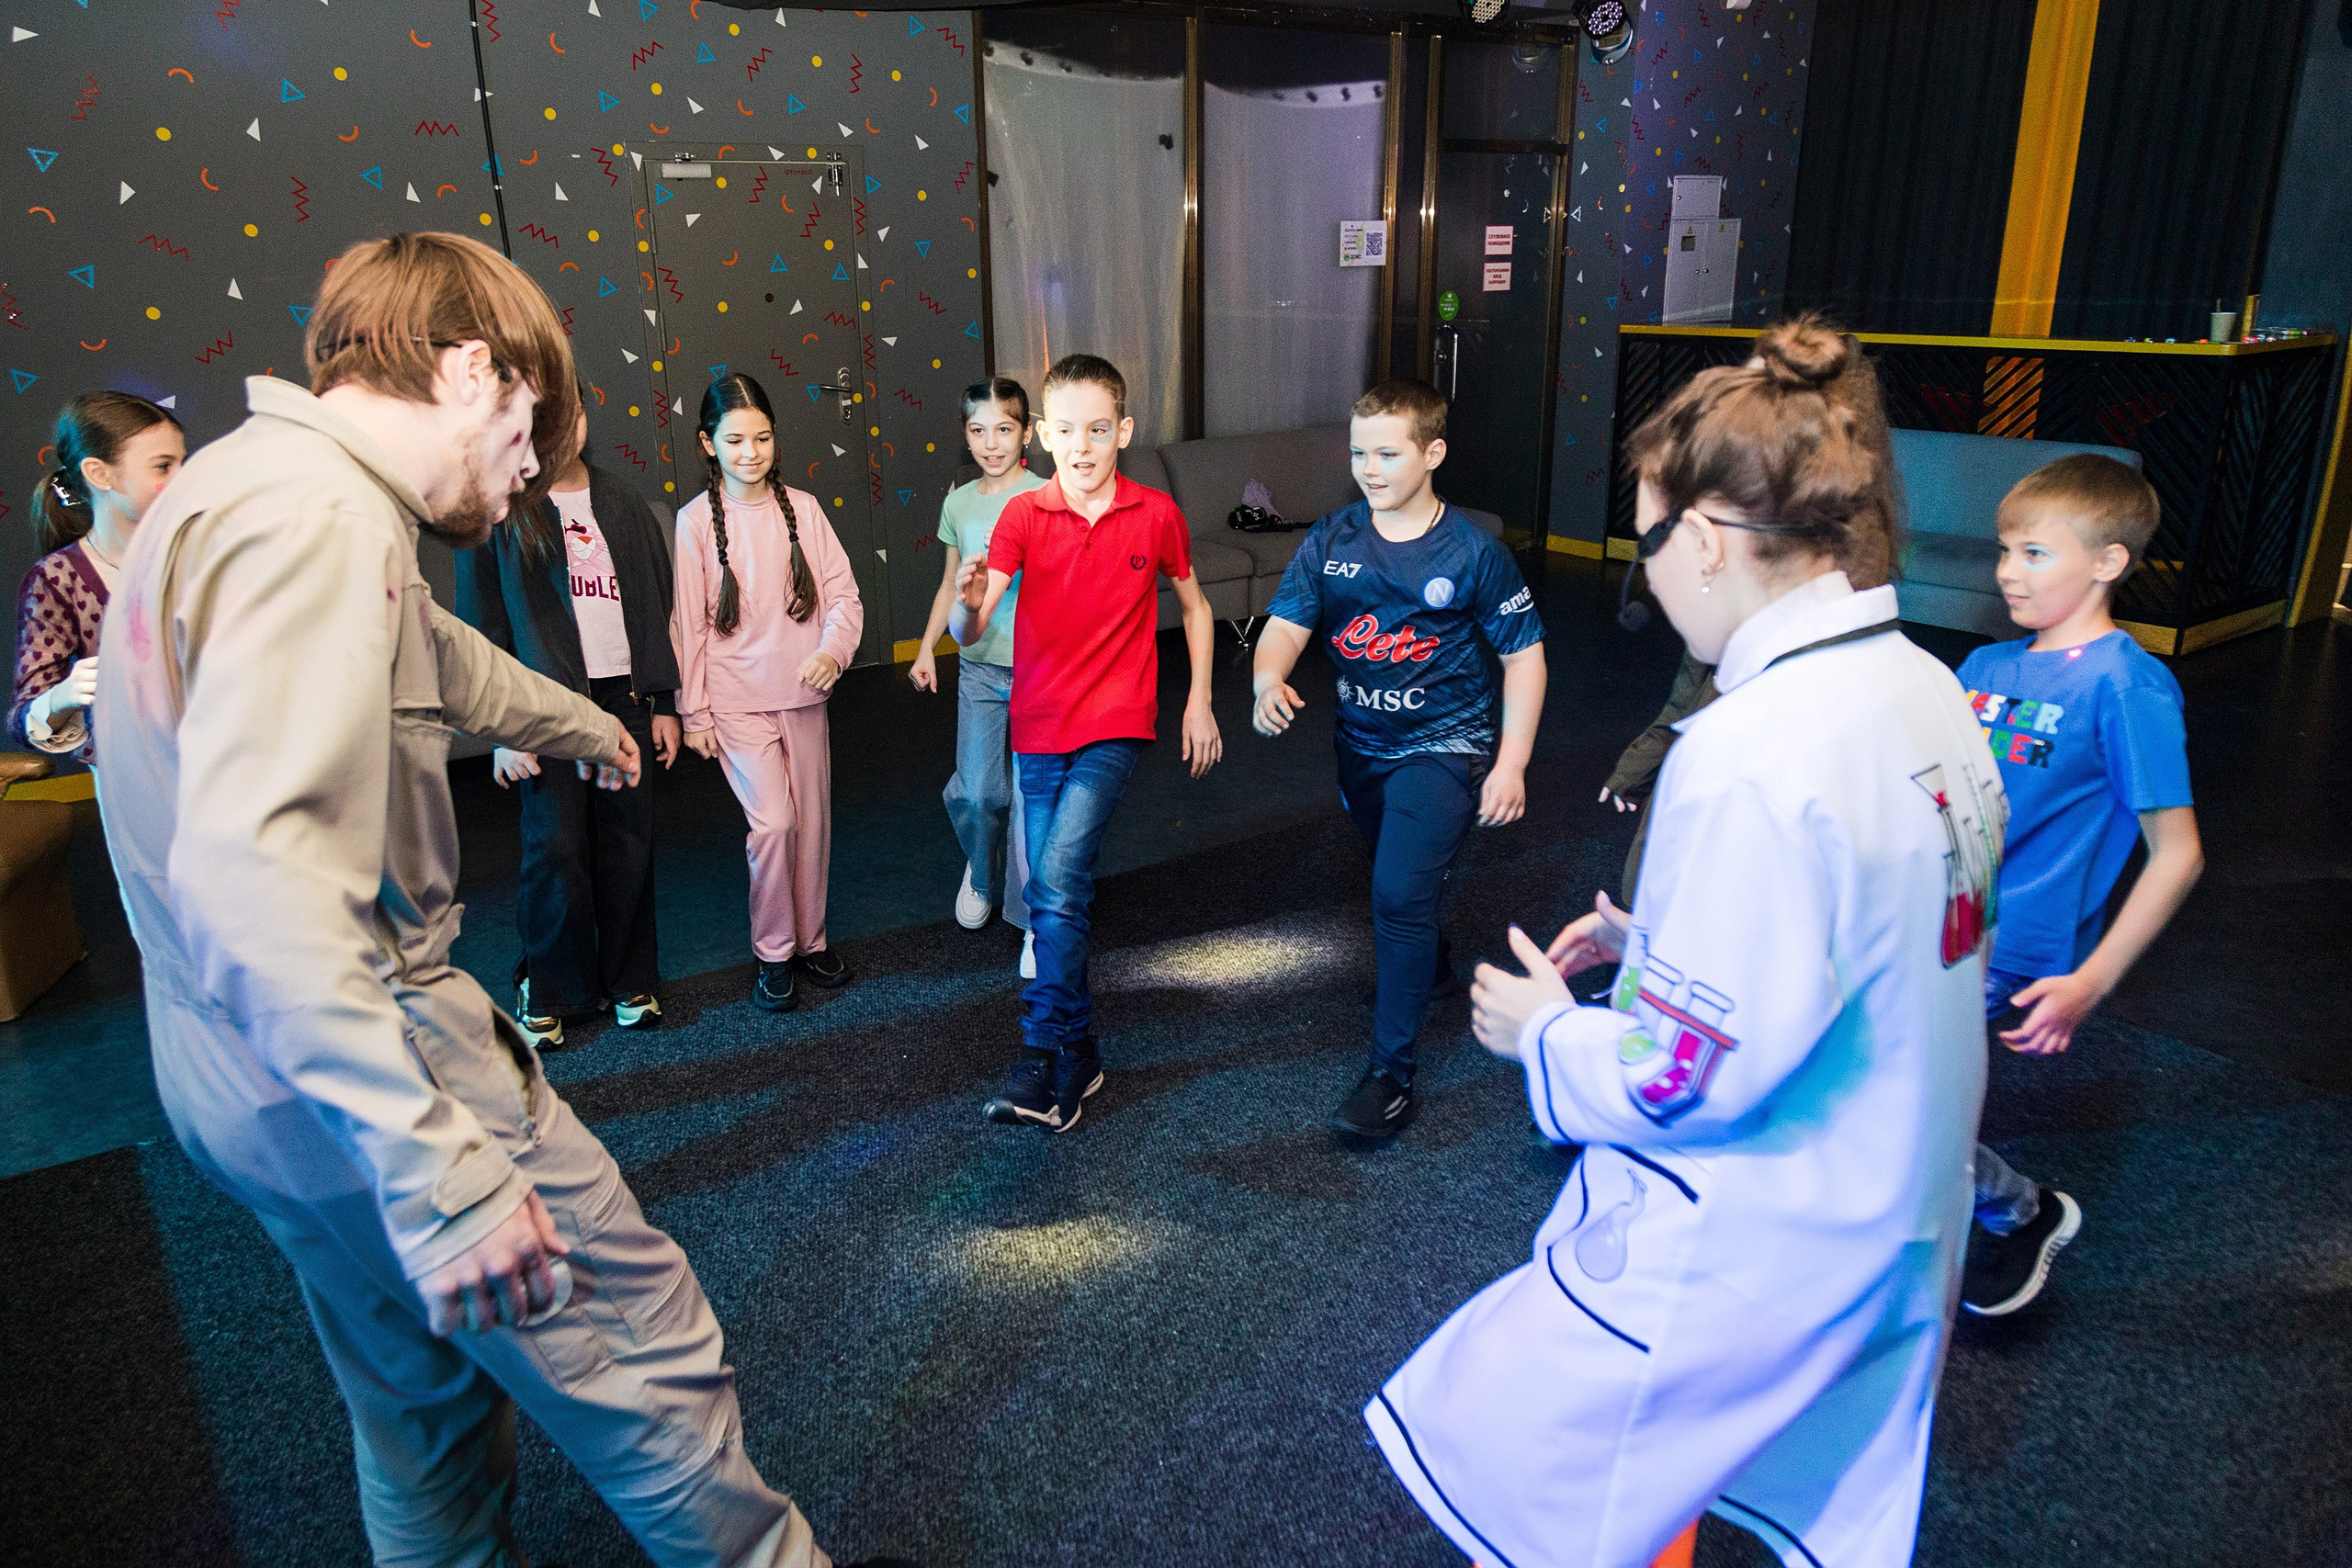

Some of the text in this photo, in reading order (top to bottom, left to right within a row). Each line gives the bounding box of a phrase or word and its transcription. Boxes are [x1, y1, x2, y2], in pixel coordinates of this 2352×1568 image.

[1135, 556, 1142, 566] P
[1323, 559, 1363, 579] EA7
[1430, 582, 1450, 603] N
[1332, 614, 1441, 663] Lete
[1355, 685, 1426, 712] MSC
[1965, 689, 2064, 735] ASTER
[1983, 726, 2054, 769] DER
